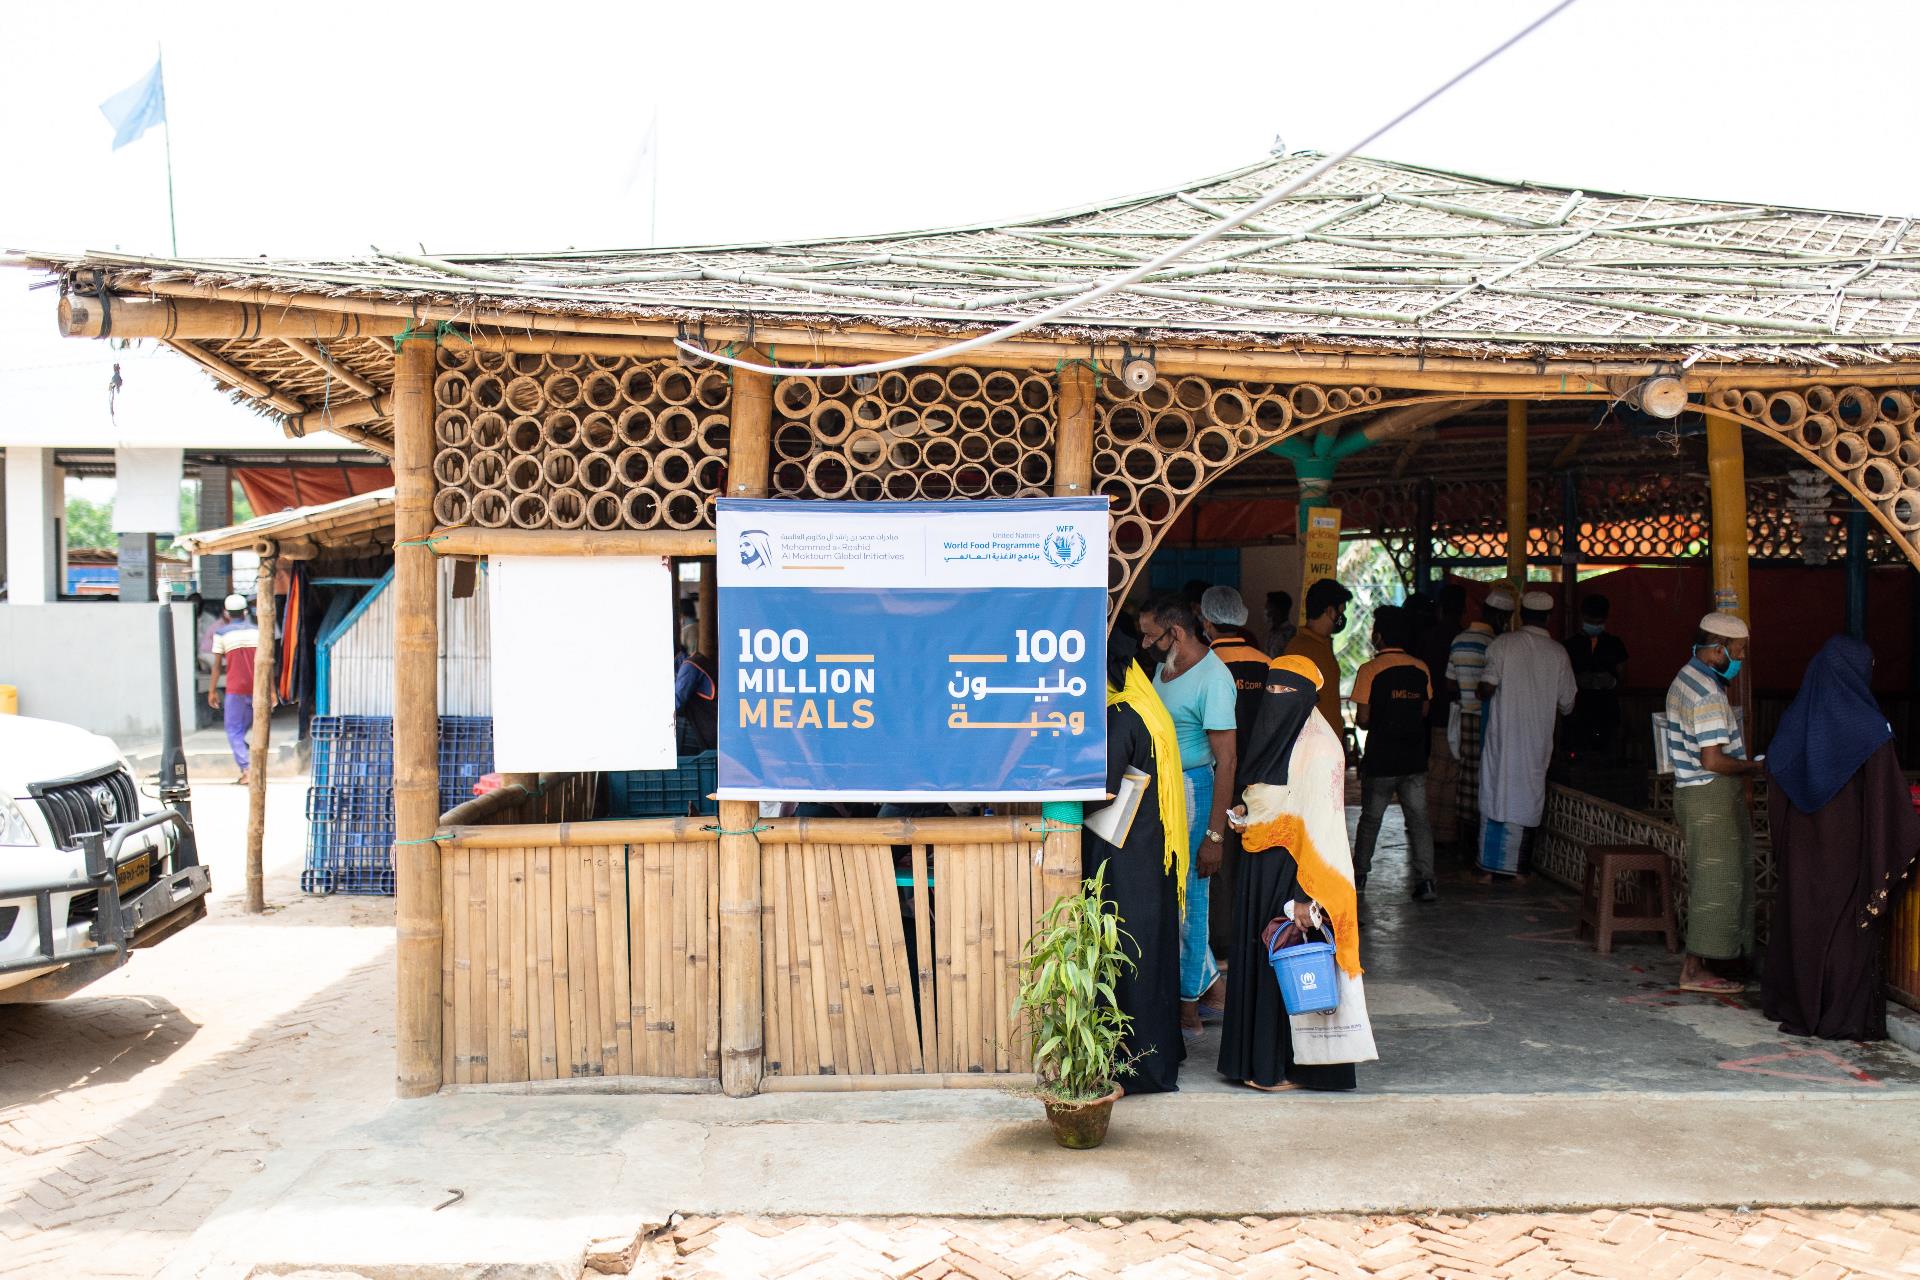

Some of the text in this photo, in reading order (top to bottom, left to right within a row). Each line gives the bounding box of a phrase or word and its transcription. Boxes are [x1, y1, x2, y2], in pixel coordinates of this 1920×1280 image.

[1056, 525, 1074, 533] WFP
[992, 532, 1041, 540] United Nations
[781, 543, 831, 551] Mohammed
[944, 541, 1040, 551] World Food Programme
[782, 551, 905, 560] Al Maktoum Global Initiatives
[1017, 552, 1040, 562] برنامج
[1311, 563, 1331, 574] WFP
[738, 628, 809, 663] 100
[1015, 629, 1086, 663] 100
[738, 668, 875, 694] MILLION
[948, 669, 1087, 702] مليون
[739, 698, 875, 729] MEALS
[948, 703, 1085, 737] وجبة
